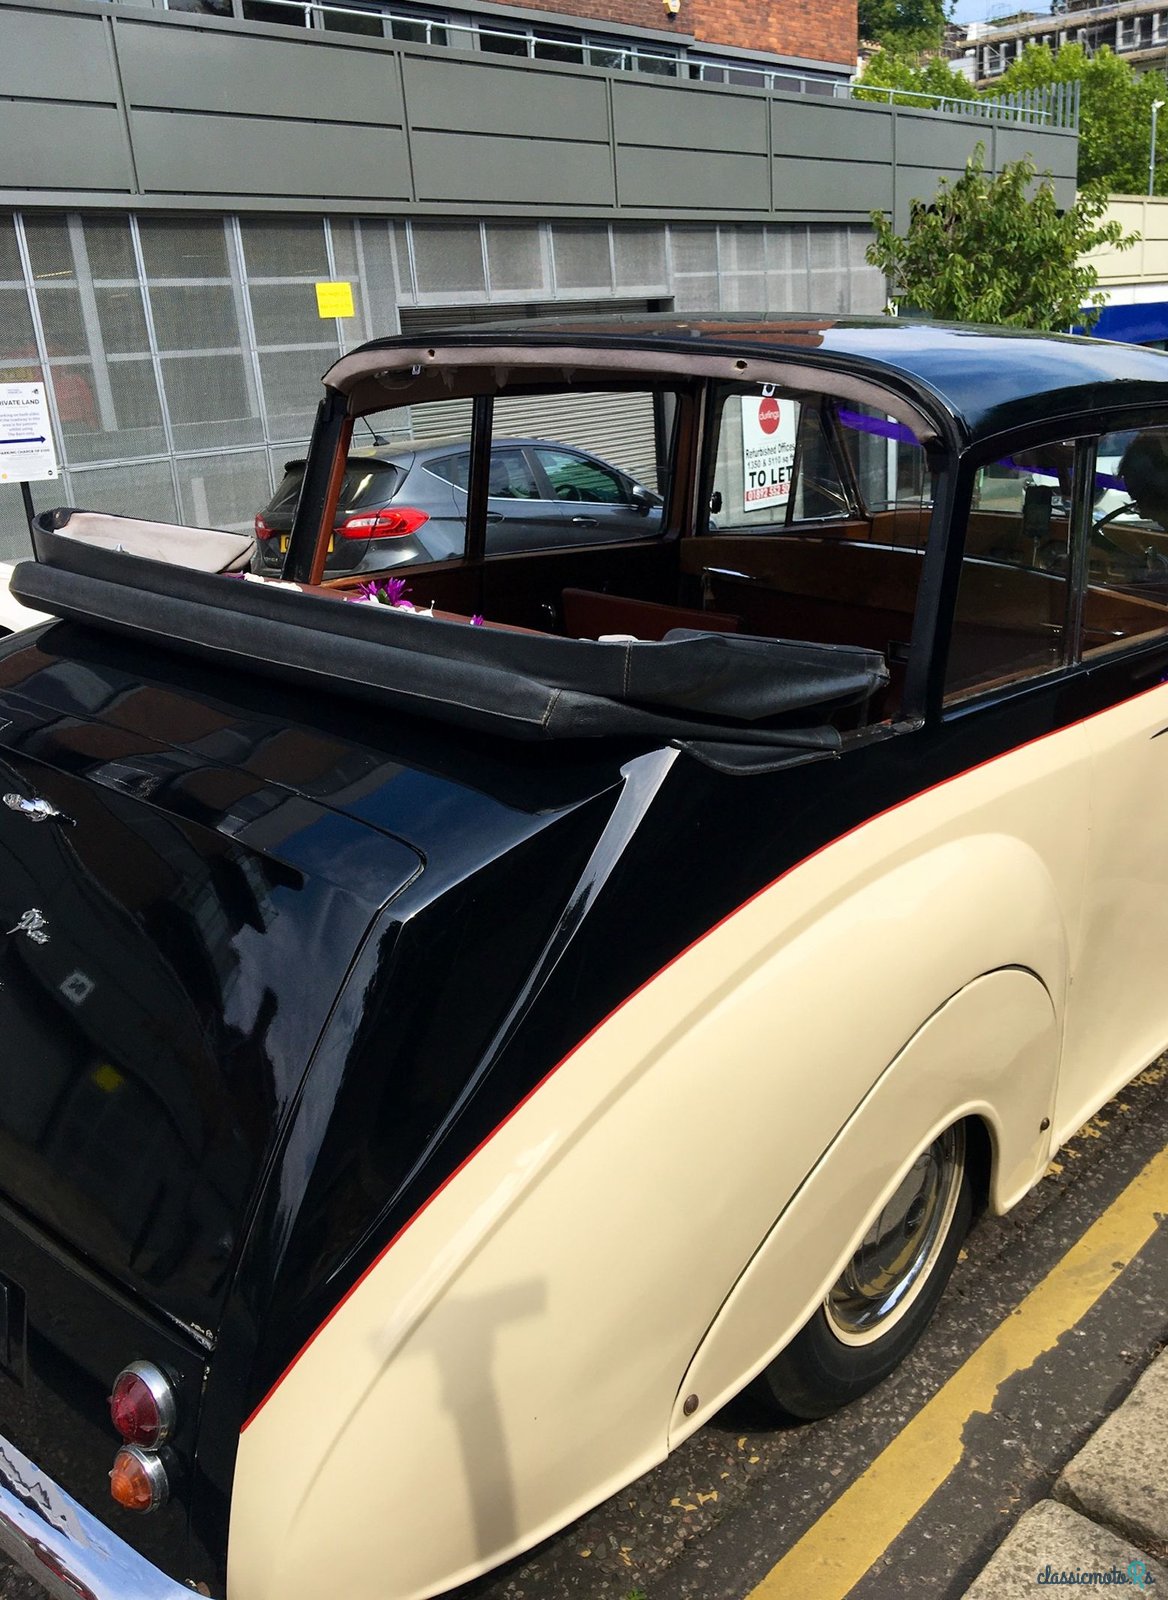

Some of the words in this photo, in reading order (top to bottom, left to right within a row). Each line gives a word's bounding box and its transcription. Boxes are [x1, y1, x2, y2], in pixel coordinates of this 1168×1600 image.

[745, 446, 777, 459] Refurbished
[749, 470, 767, 489] TO
[770, 465, 793, 485] LET
[748, 488, 768, 501] 01892
